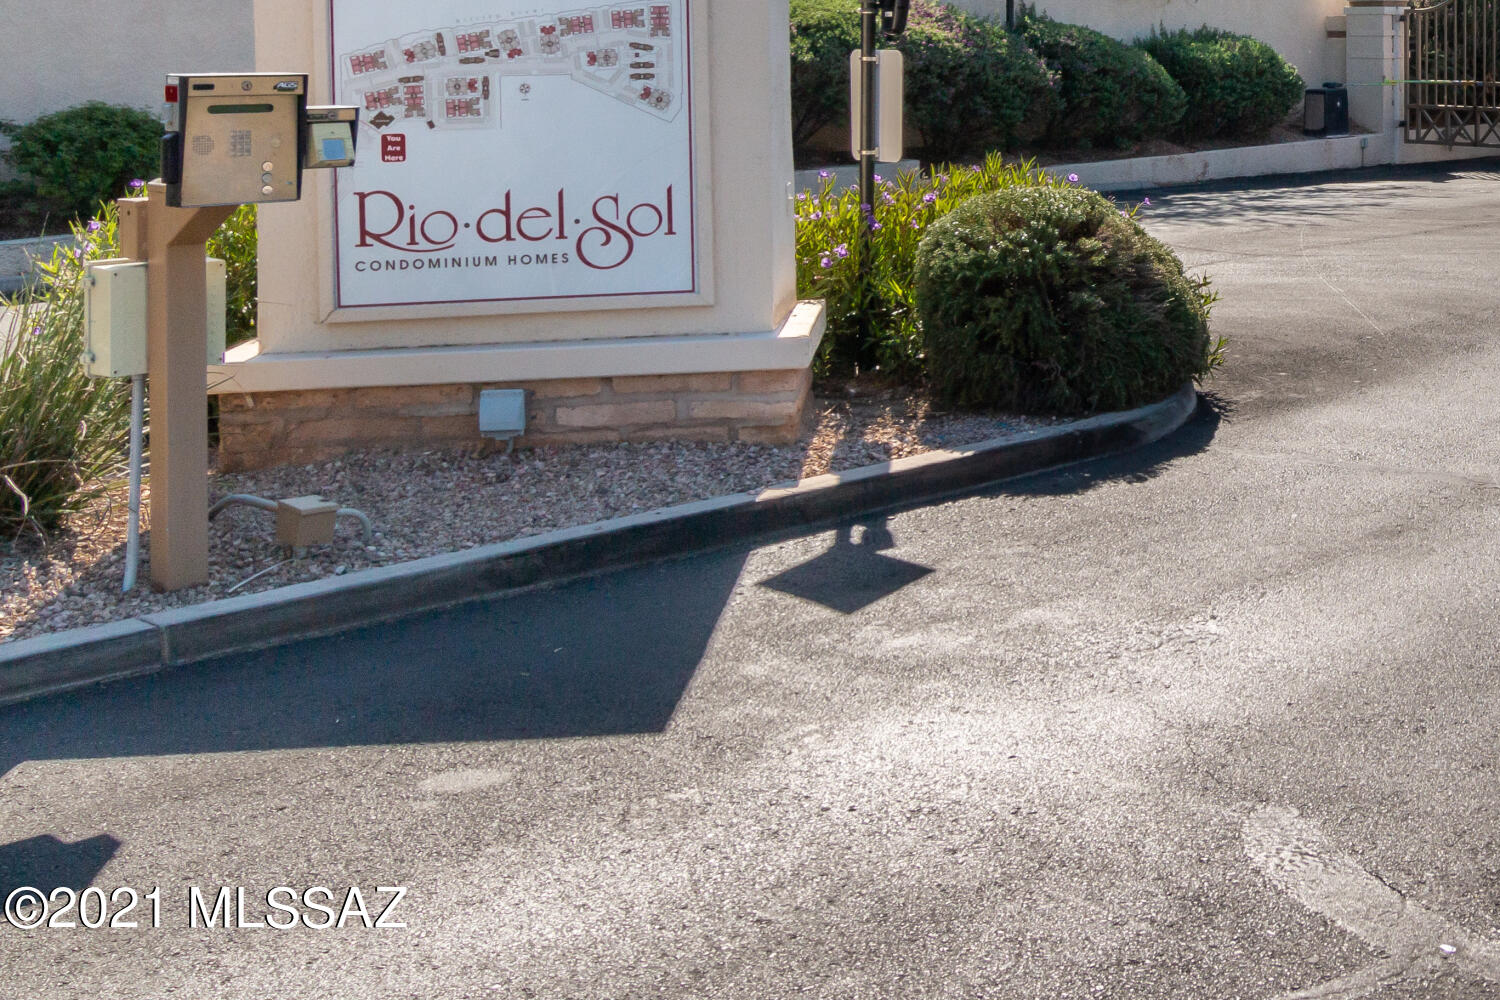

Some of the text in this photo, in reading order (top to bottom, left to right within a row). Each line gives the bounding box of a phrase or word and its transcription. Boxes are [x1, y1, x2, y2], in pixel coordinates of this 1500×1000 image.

[353, 184, 677, 270] Rio del Sol
[354, 252, 570, 272] CONDOMINIUM HOMES
